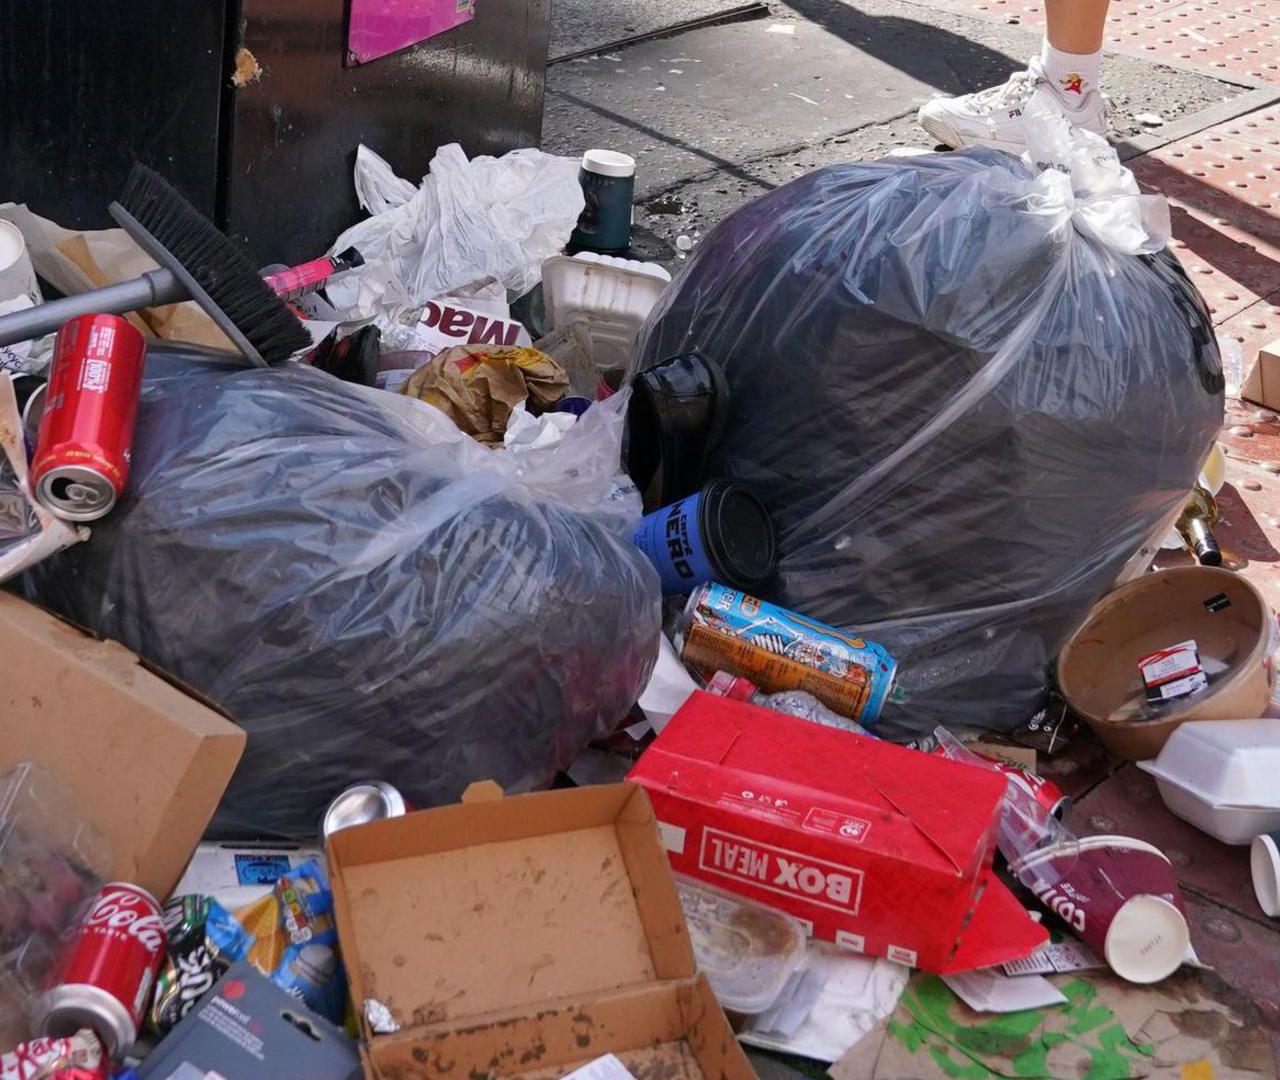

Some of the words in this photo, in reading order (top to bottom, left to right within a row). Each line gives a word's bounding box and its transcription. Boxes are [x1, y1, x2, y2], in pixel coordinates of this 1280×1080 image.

[664, 499, 696, 580] NERO
[711, 836, 770, 880] MEAL
[773, 855, 853, 904] BOX
[89, 890, 165, 954] Cola
